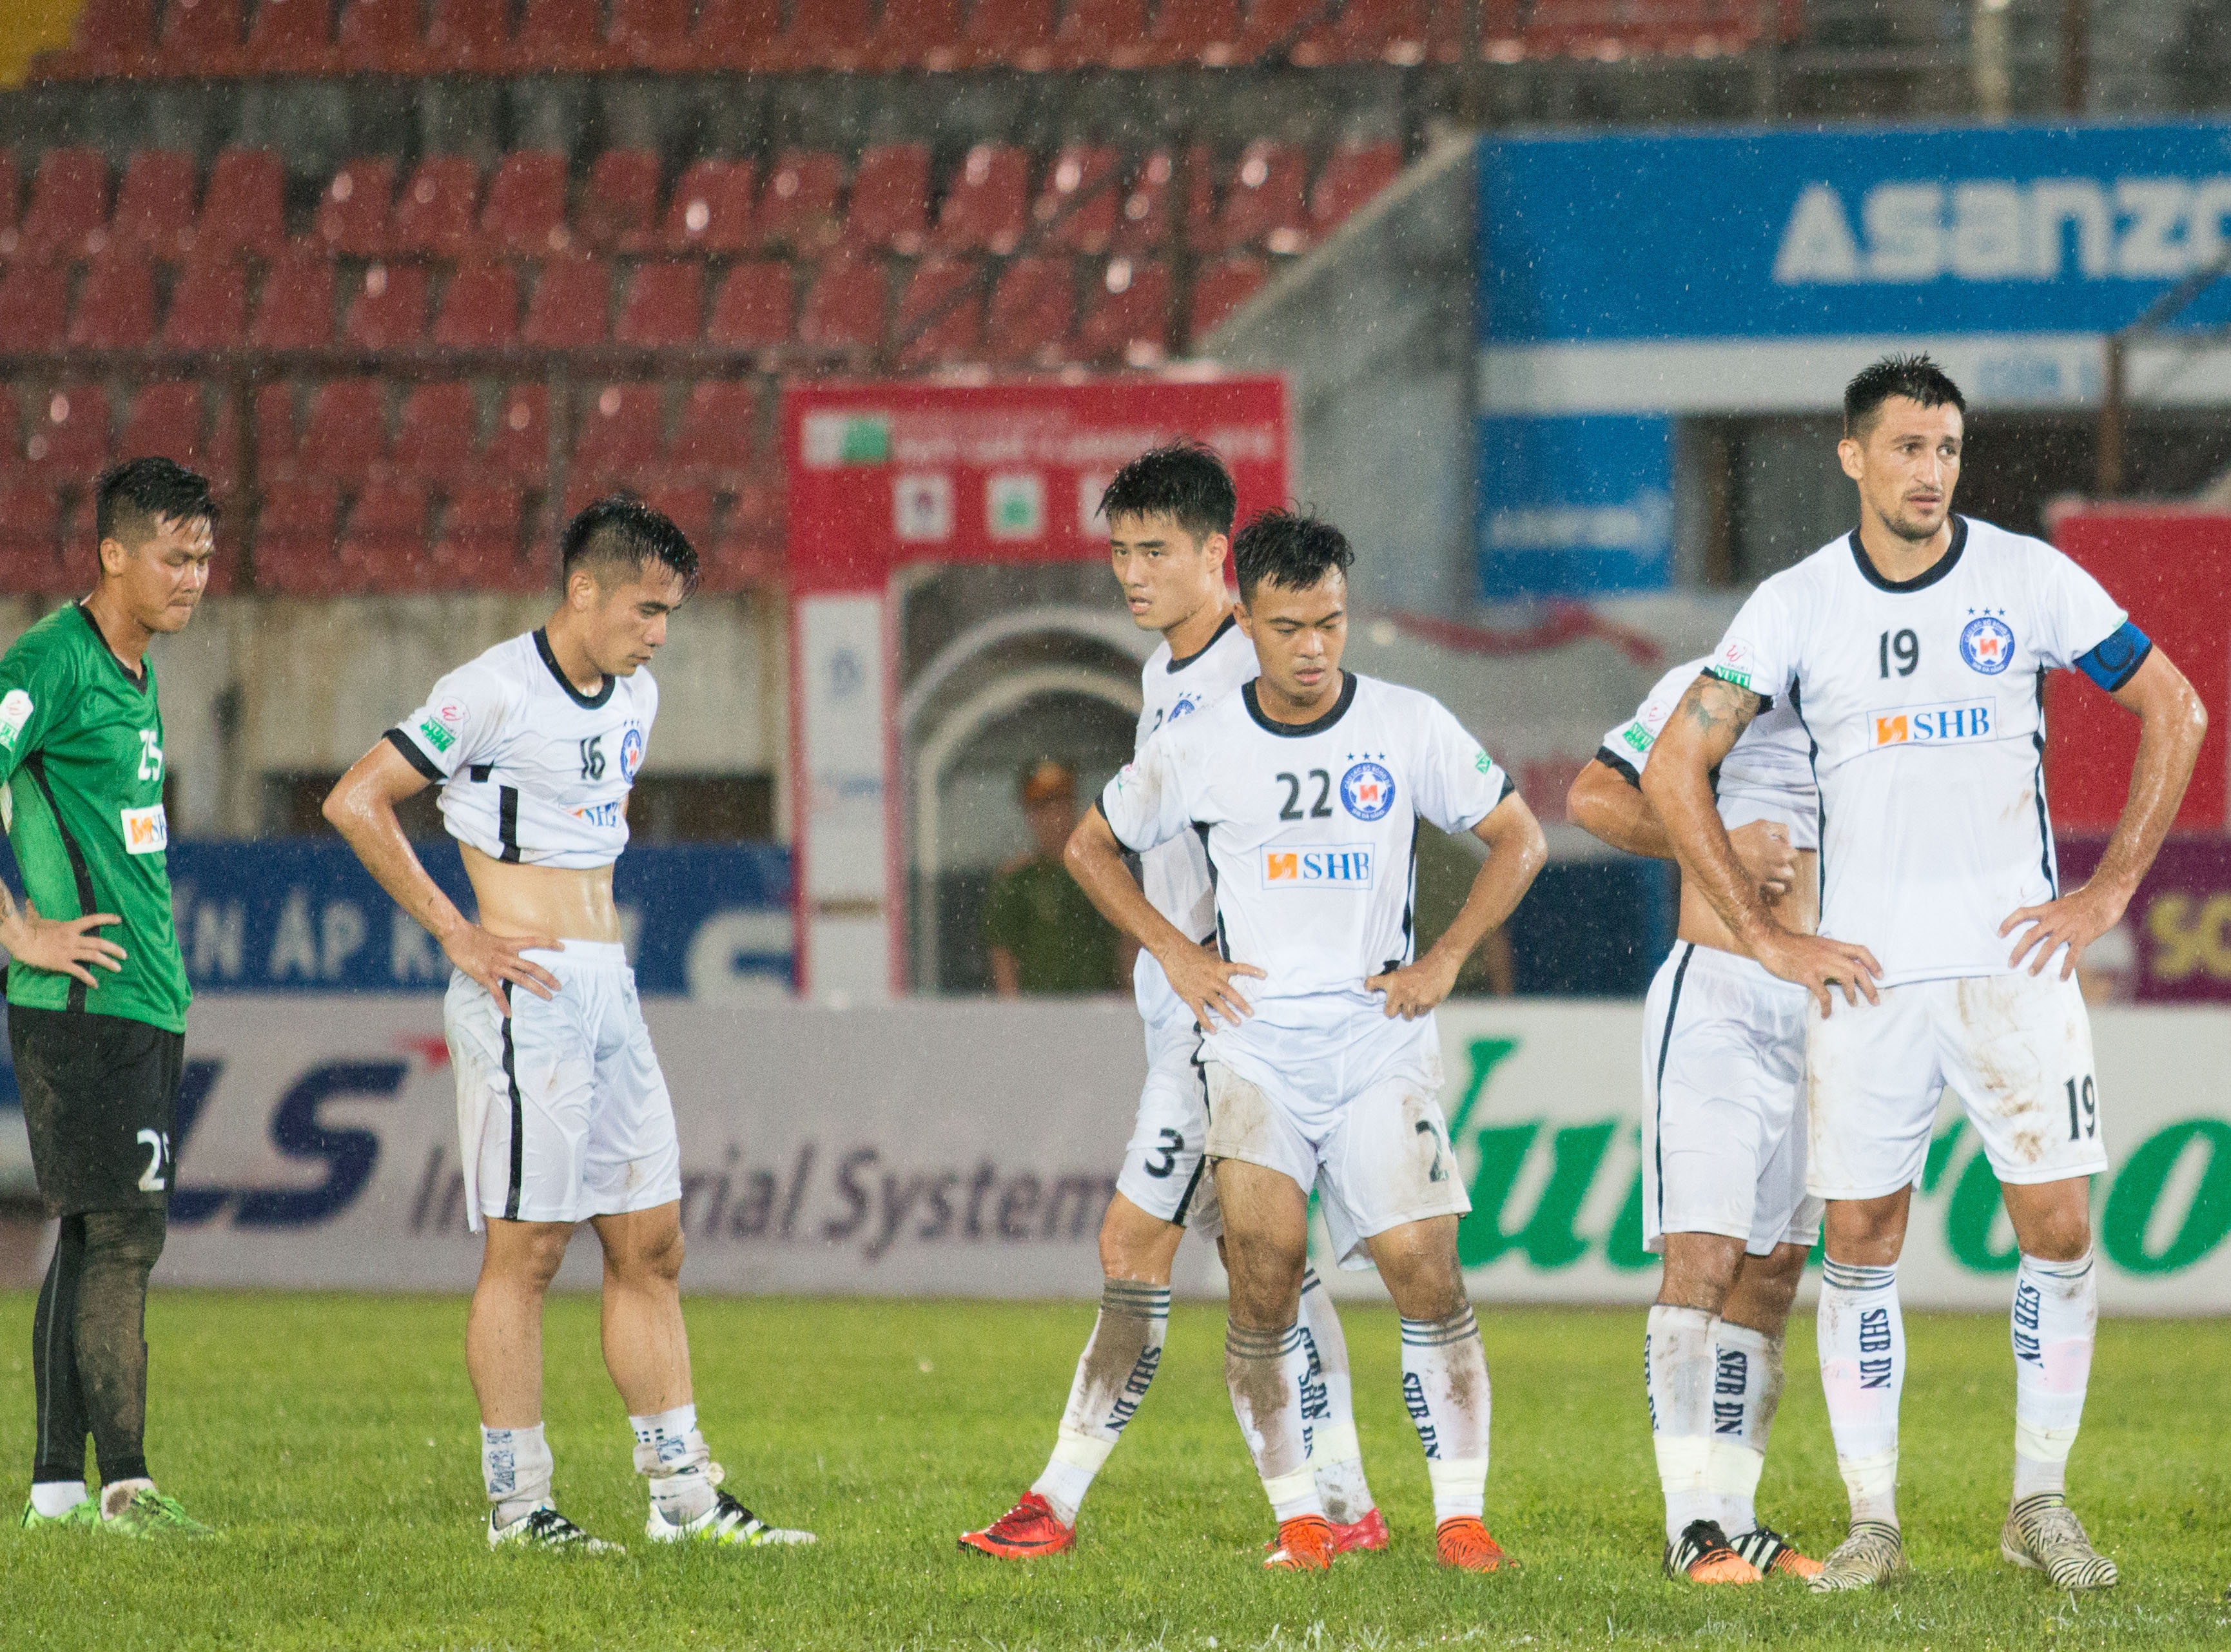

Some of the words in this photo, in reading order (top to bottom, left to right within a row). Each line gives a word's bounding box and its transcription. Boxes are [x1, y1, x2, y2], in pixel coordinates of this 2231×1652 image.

[1878, 628, 1920, 679] 19
[1913, 706, 1990, 741] SHB
[137, 730, 163, 782] 25
[580, 735, 606, 781] 16
[1276, 768, 1333, 822] 22
[1303, 851, 1369, 880] SHB
[2064, 1074, 2095, 1142] 19
[1144, 1127, 1185, 1179] 3
[1860, 1308, 1891, 1352] SHB
[2014, 1279, 2040, 1330] SHB
[1125, 1345, 1162, 1395] SHB
[1715, 1343, 1748, 1395] SHB
[1403, 1372, 1430, 1419] SHB
